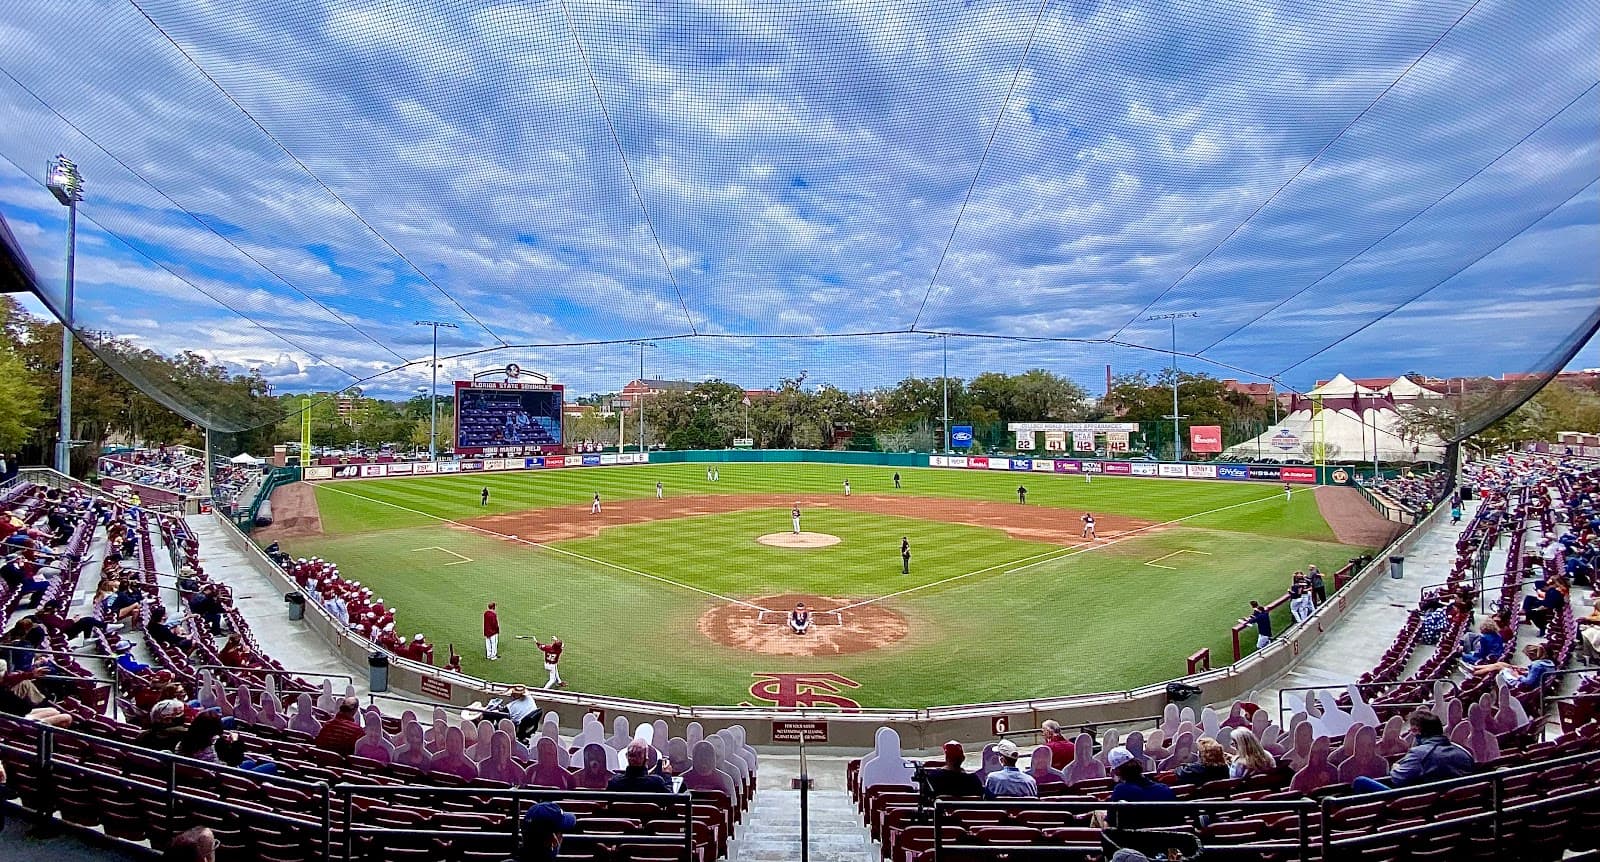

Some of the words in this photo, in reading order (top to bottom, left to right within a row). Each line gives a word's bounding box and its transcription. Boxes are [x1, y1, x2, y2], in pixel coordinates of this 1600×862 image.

[1018, 440, 1030, 448] 22
[1049, 441, 1062, 450] 41
[1077, 441, 1092, 450] 42
[1111, 442, 1126, 451] 42
[342, 466, 358, 476] 40
[995, 718, 1006, 733] 6
